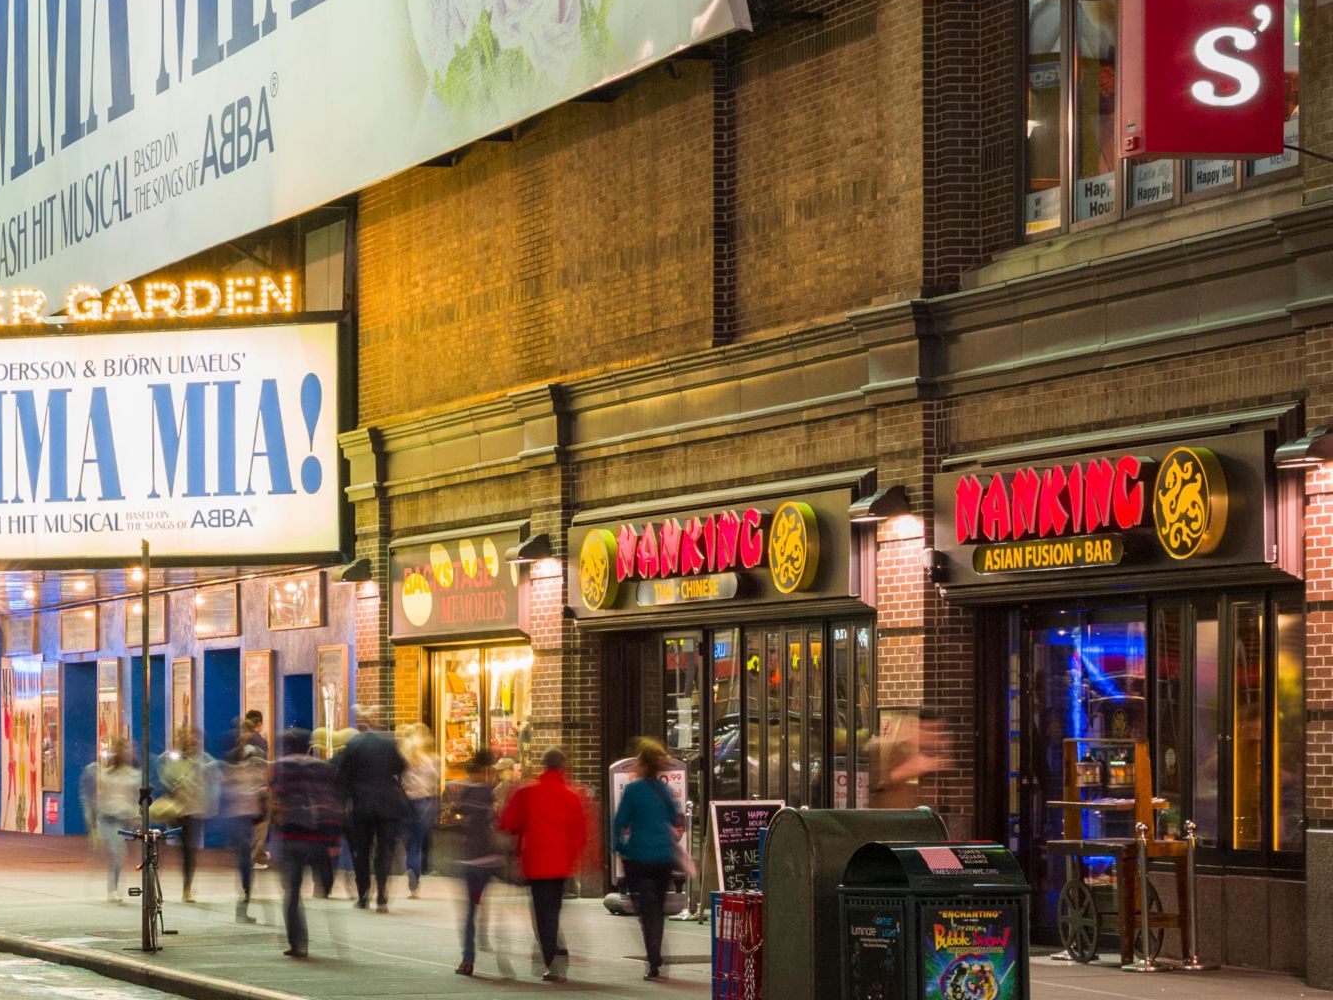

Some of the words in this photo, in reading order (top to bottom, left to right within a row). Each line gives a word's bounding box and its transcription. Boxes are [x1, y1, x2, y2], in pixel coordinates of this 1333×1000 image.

[200, 86, 275, 186] ABBA
[134, 139, 162, 178] BASED
[164, 130, 179, 163] ON
[134, 182, 151, 214] THE
[152, 165, 183, 208] SONGS
[186, 159, 200, 192] OF
[1197, 167, 1219, 185] Happy
[1137, 185, 1159, 201] Happy
[33, 194, 56, 265] HIT
[61, 155, 133, 250] MUSICAL
[66, 274, 294, 322] GARDEN
[83, 359, 97, 379] &
[103, 353, 163, 379] BJÖRN
[167, 351, 247, 376] ULVAEUS'
[147, 371, 324, 500] MIA!
[955, 455, 1144, 545] NANKING
[7, 514, 38, 535] HIT
[43, 512, 125, 534] MUSICAL
[125, 511, 154, 522] BASED
[155, 510, 171, 521] ON
[126, 523, 142, 533] THE
[143, 521, 175, 532] SONGS
[190, 508, 254, 530] ABBA
[616, 508, 764, 583] NANKING
[984, 547, 1023, 571] ASIAN
[1025, 542, 1074, 568] FUSION
[1084, 539, 1113, 563] BAR
[403, 556, 494, 595] BACKSTAGE
[681, 579, 720, 599] CHINESE
[440, 590, 507, 624] MEMORIES
[747, 810, 769, 819] HAPPY
[748, 819, 768, 827] HOURS
[933, 923, 971, 951] Bubble
